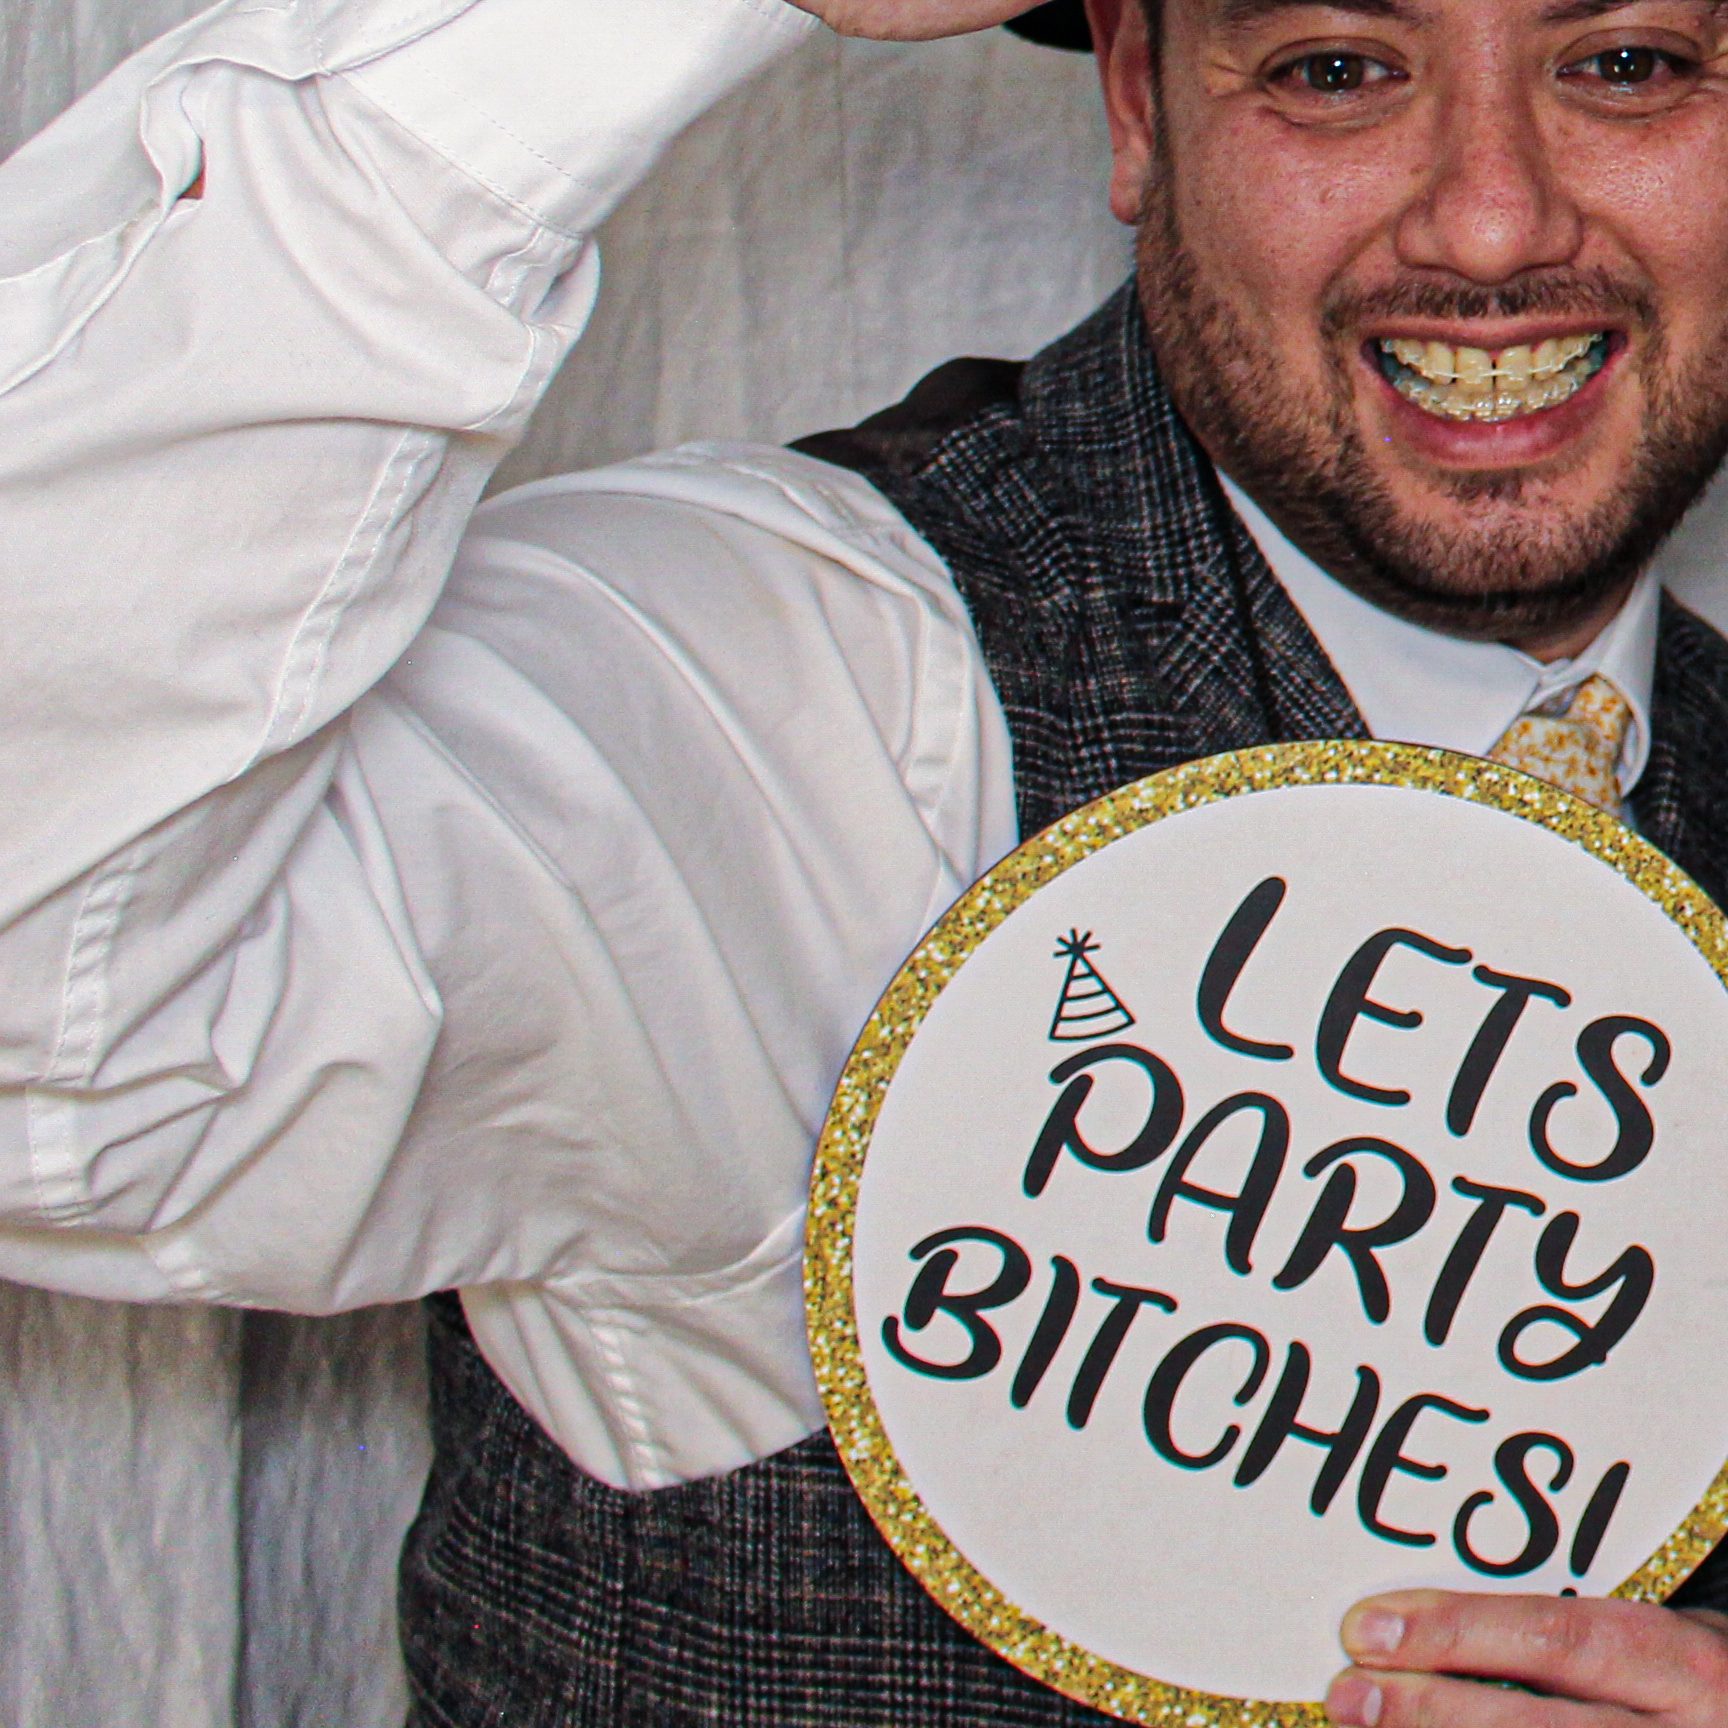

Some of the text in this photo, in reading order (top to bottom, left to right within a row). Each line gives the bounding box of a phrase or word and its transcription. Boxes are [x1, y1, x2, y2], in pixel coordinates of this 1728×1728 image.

[1198, 876, 1672, 1183] LETS
[1022, 1043, 1656, 1382] PARTY
[881, 1225, 1631, 1598] BITCHES!
